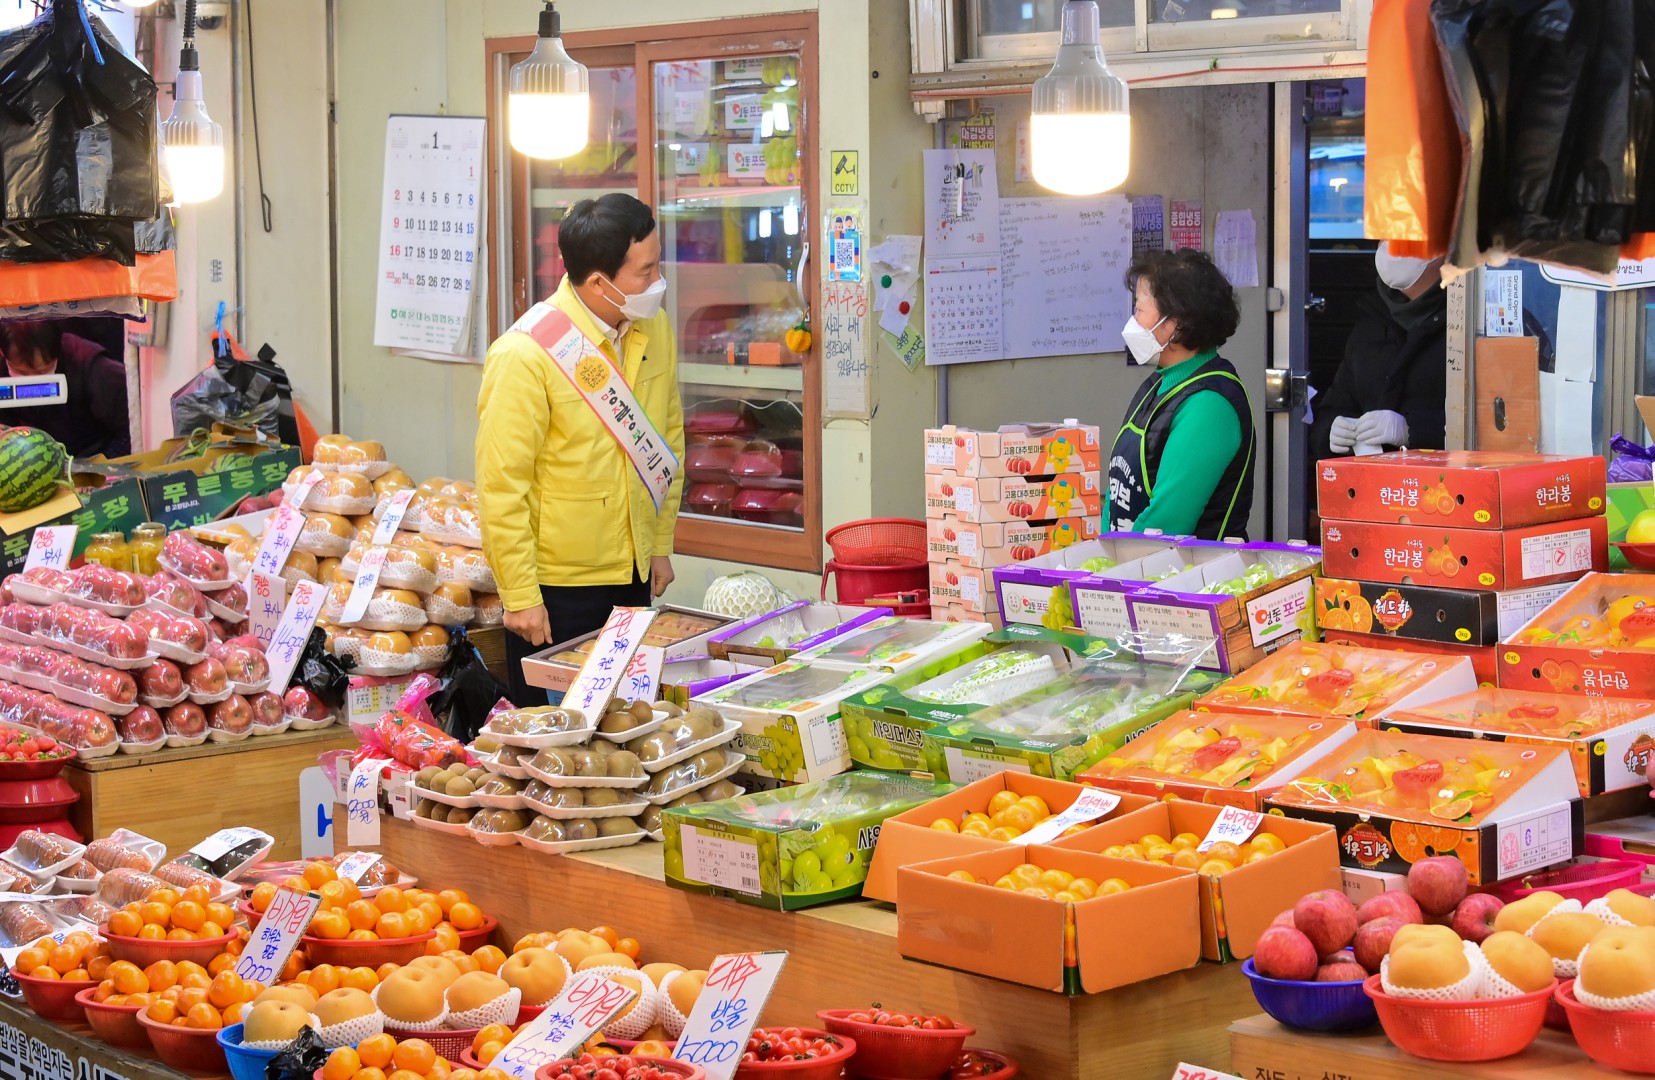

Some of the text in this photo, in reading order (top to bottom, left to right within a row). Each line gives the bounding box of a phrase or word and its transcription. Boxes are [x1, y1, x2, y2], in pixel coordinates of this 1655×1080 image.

[432, 132, 439, 149] 1
[962, 127, 994, 140] 대림냉동
[469, 166, 474, 177] 1
[395, 190, 473, 206] 2 3 4 5 6 7 8
[835, 184, 854, 192] CCTV
[394, 218, 474, 234] 9 10 11 12 13 14 15
[1171, 212, 1201, 226] 종합냉동
[390, 245, 473, 262] 16 17 18 19 20 21 22
[416, 275, 425, 286] 25
[428, 276, 437, 288] 26
[441, 277, 450, 289] 27
[454, 278, 462, 290] 28
[823, 285, 866, 317] 제수용
[825, 313, 859, 341] 사과 배
[825, 338, 852, 360] 냉장고에
[163, 462, 288, 504] 푸른농장
[1380, 487, 1488, 521] 한라봉 3kg
[1535, 485, 1601, 508] 한라봉 3kg
[2, 495, 129, 558] 푸농장
[274, 534, 290, 551] 부사
[41, 548, 62, 565] 부사
[1384, 548, 1423, 568] 한라봉
[1557, 550, 1565, 563] 7
[263, 600, 281, 620] 부사
[294, 608, 313, 627] 부사
[1283, 597, 1306, 618] 포도
[1375, 599, 1410, 619] 레드향
[1582, 669, 1629, 690] 한라봉
[1626, 748, 1652, 772] 드향
[348, 799, 375, 820] 8000
[1223, 809, 1260, 830] 비가림
[1217, 823, 1243, 836] 하우스
[1344, 835, 1389, 858] 레드향
[268, 891, 310, 934] 비가림
[261, 928, 281, 942] 하우스
[706, 954, 762, 1000] 대추
[568, 976, 631, 1028] 비가림
[549, 1012, 576, 1030] 하우스
[710, 999, 750, 1032] 방울
[676, 1036, 739, 1062] 5000
[31, 1039, 72, 1080] 책임지는
